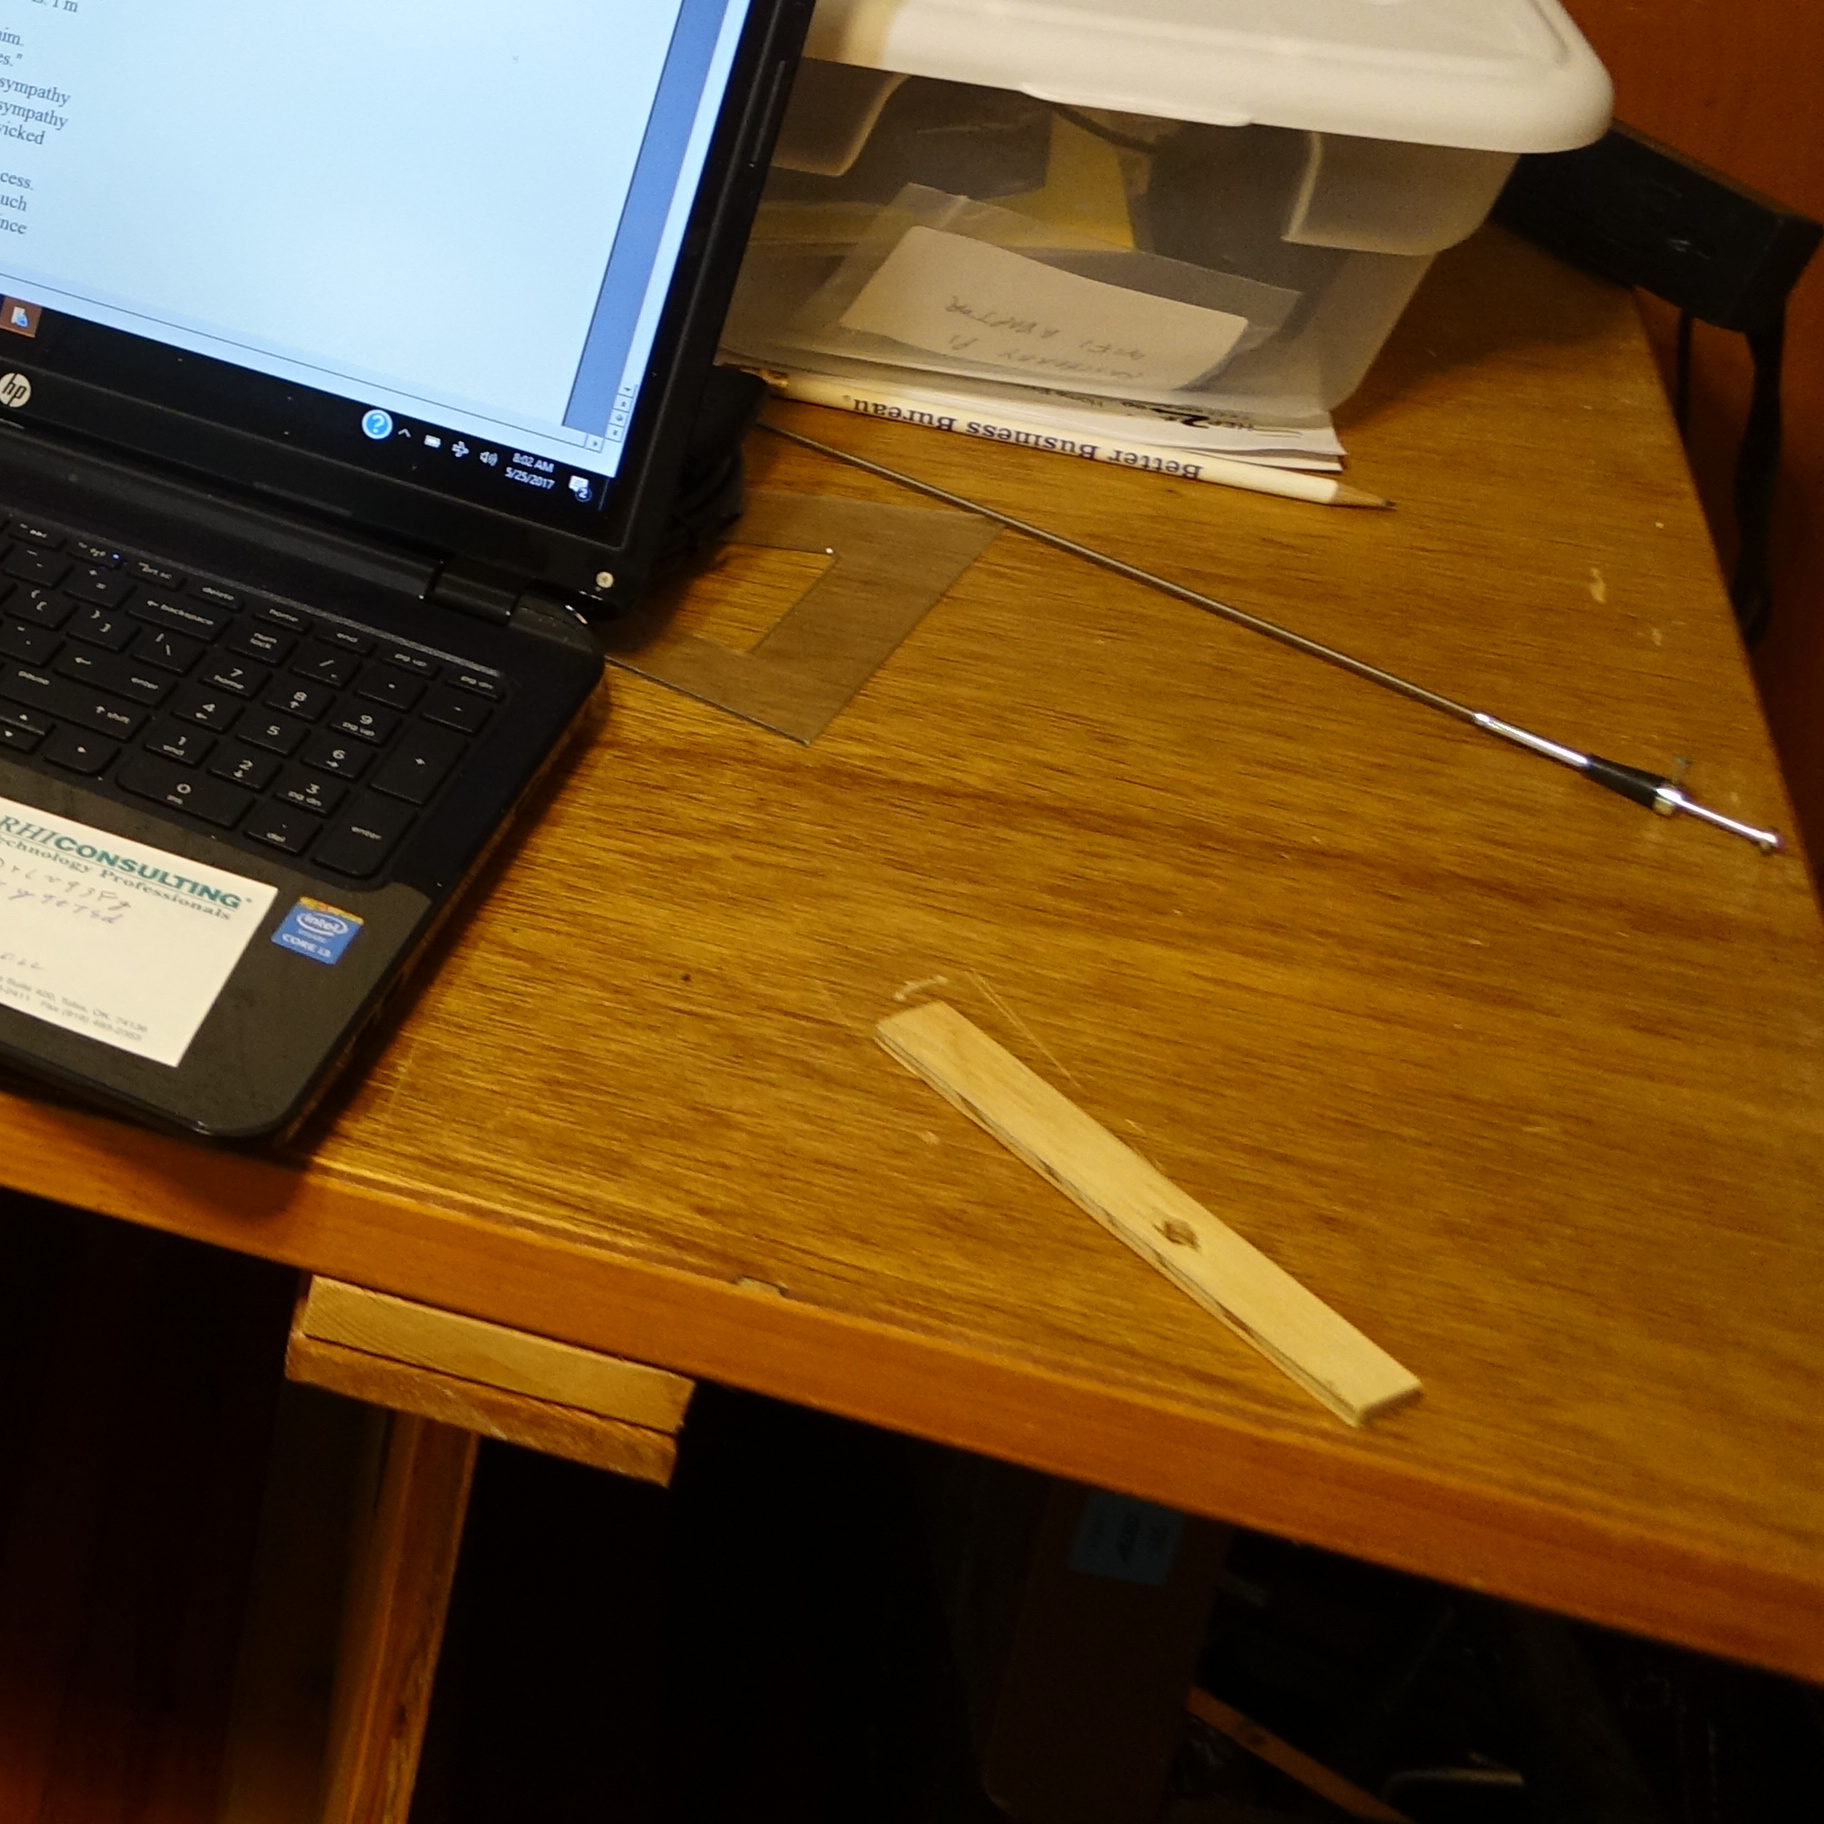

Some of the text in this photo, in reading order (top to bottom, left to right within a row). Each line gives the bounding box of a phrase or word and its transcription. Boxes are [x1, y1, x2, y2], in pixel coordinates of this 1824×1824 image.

[853, 397, 1203, 480] Better Business Bureau
[504, 466, 556, 490] 5/25/2017
[534, 459, 555, 473] AM
[101, 867, 232, 922] Professionals
[282, 933, 318, 953] CORE
